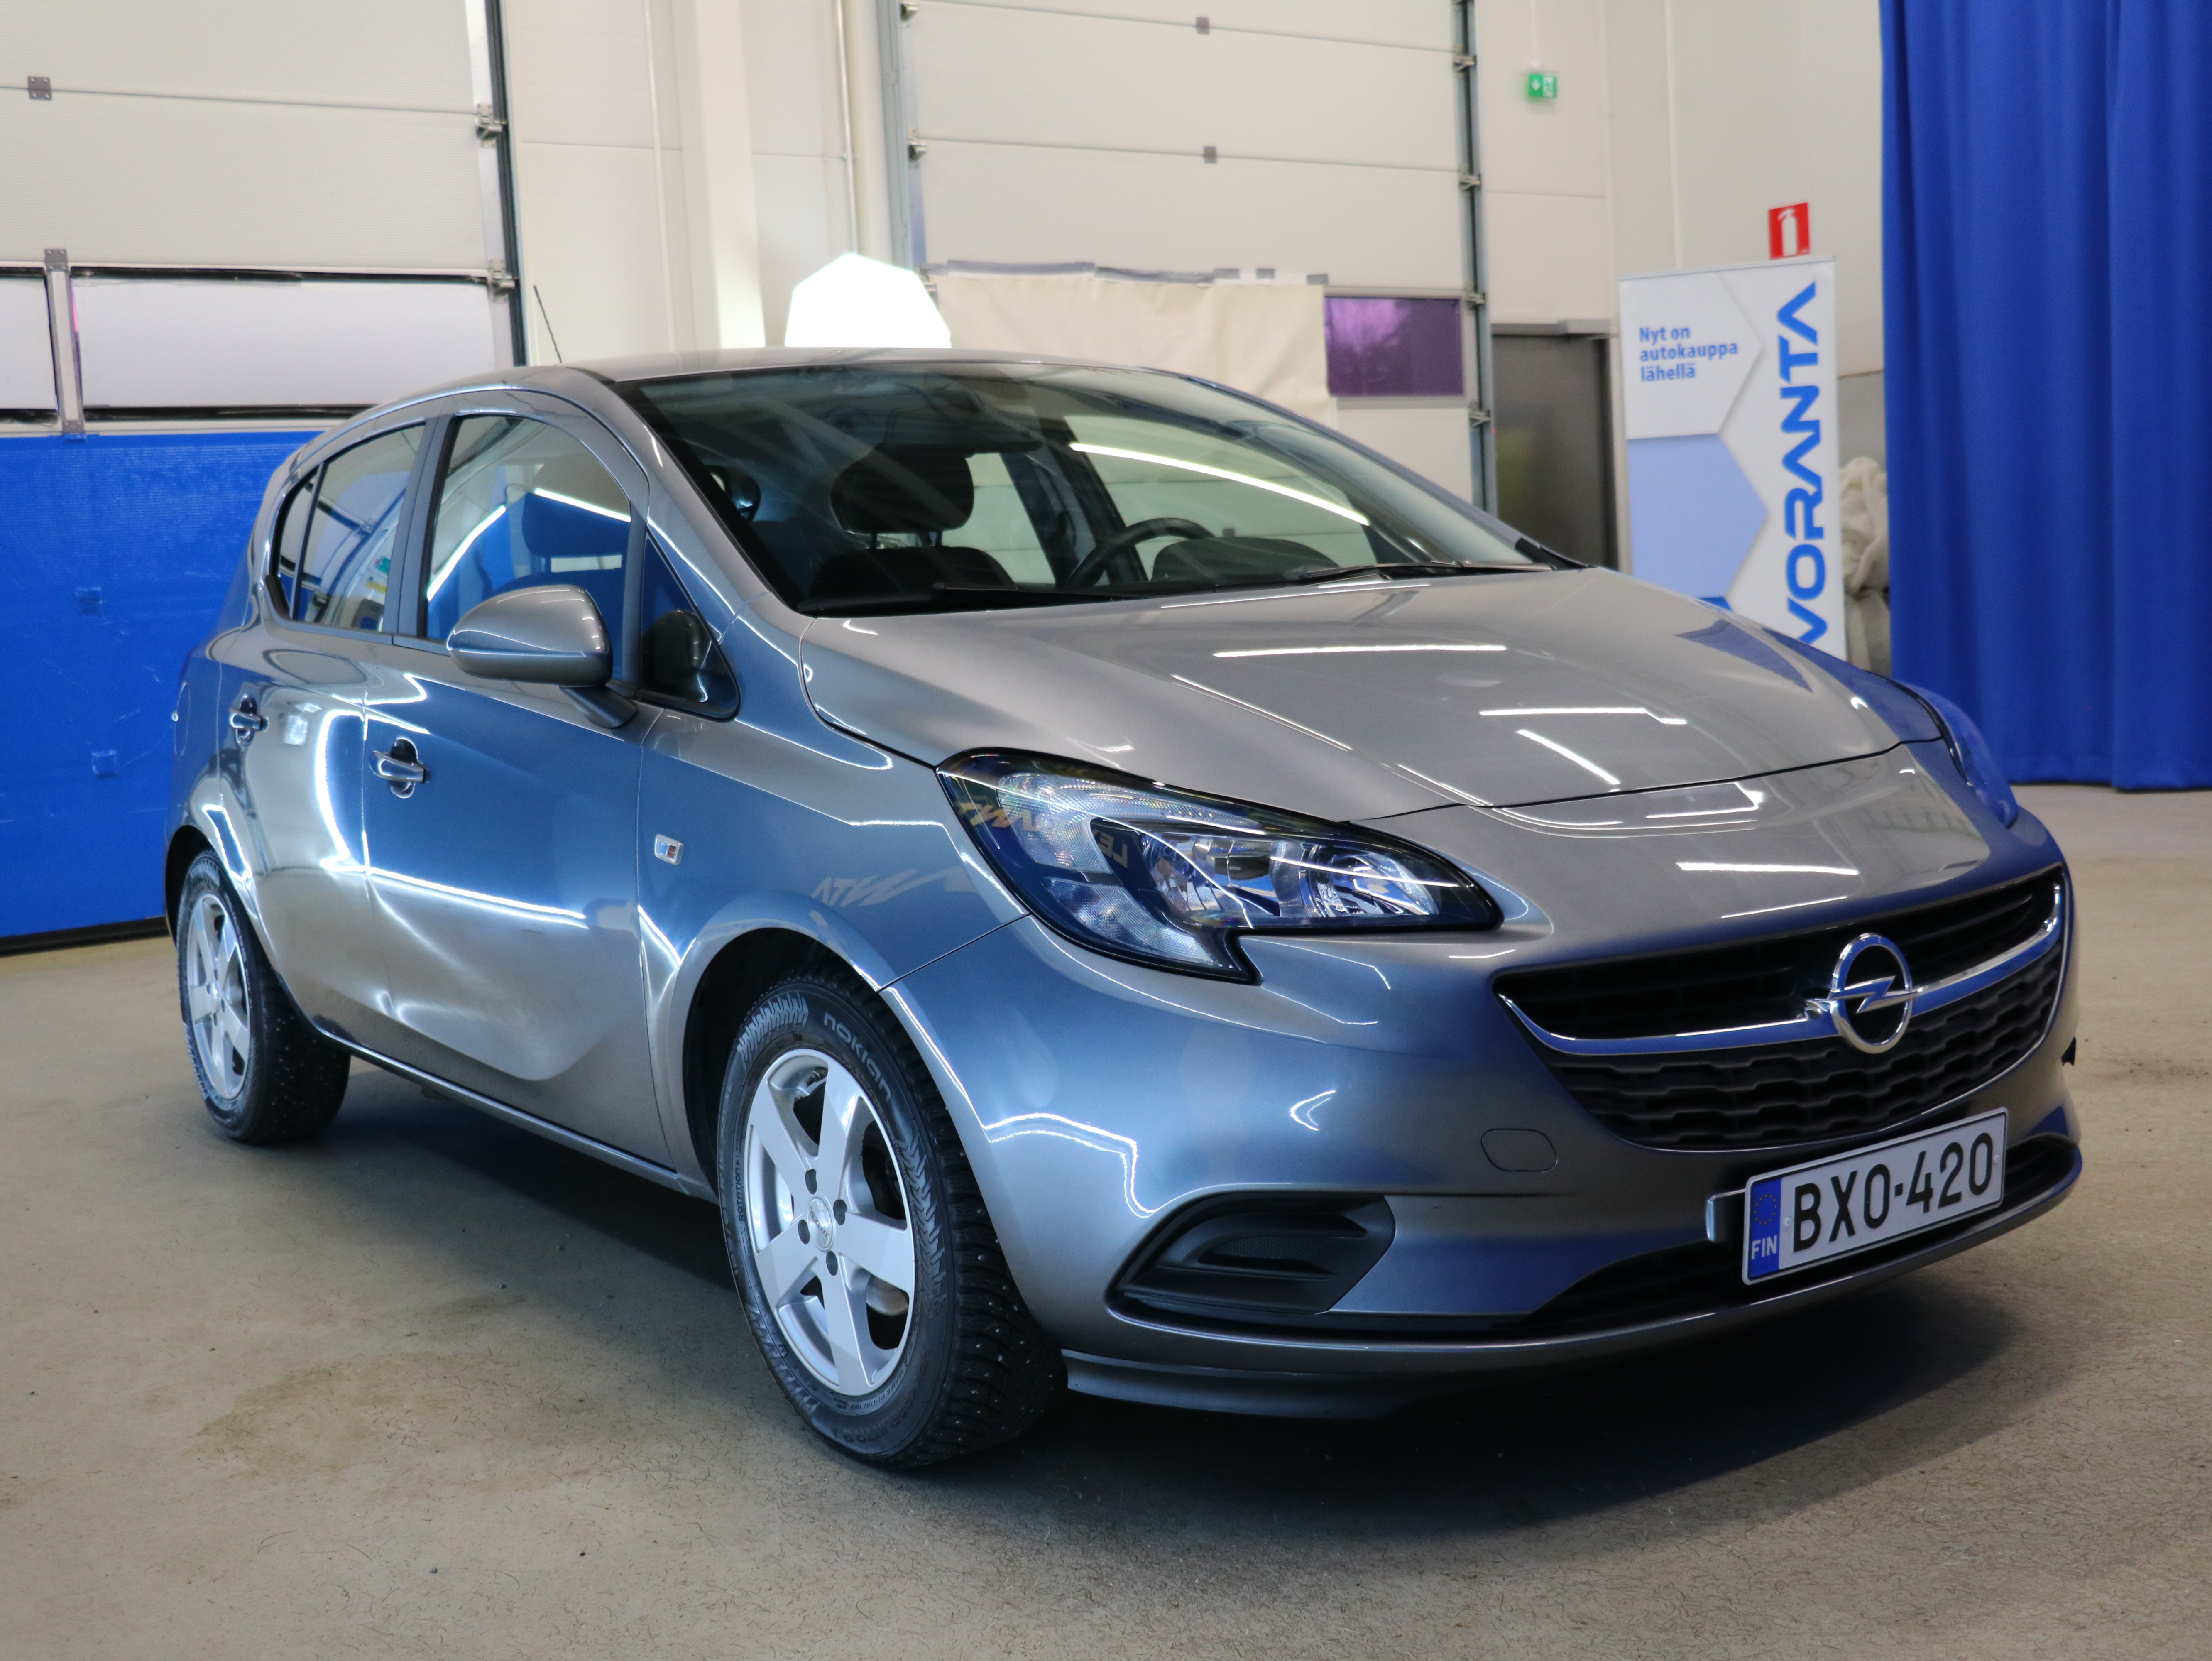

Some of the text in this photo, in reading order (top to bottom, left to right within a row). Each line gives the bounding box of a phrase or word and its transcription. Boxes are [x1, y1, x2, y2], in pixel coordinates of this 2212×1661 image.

[1639, 327, 1690, 345] Nyt on
[1640, 343, 1738, 361] autokauppa
[1641, 363, 1695, 382] lähellä
[1794, 1133, 1993, 1252] BXO-420
[1752, 1235, 1777, 1260] FIN
